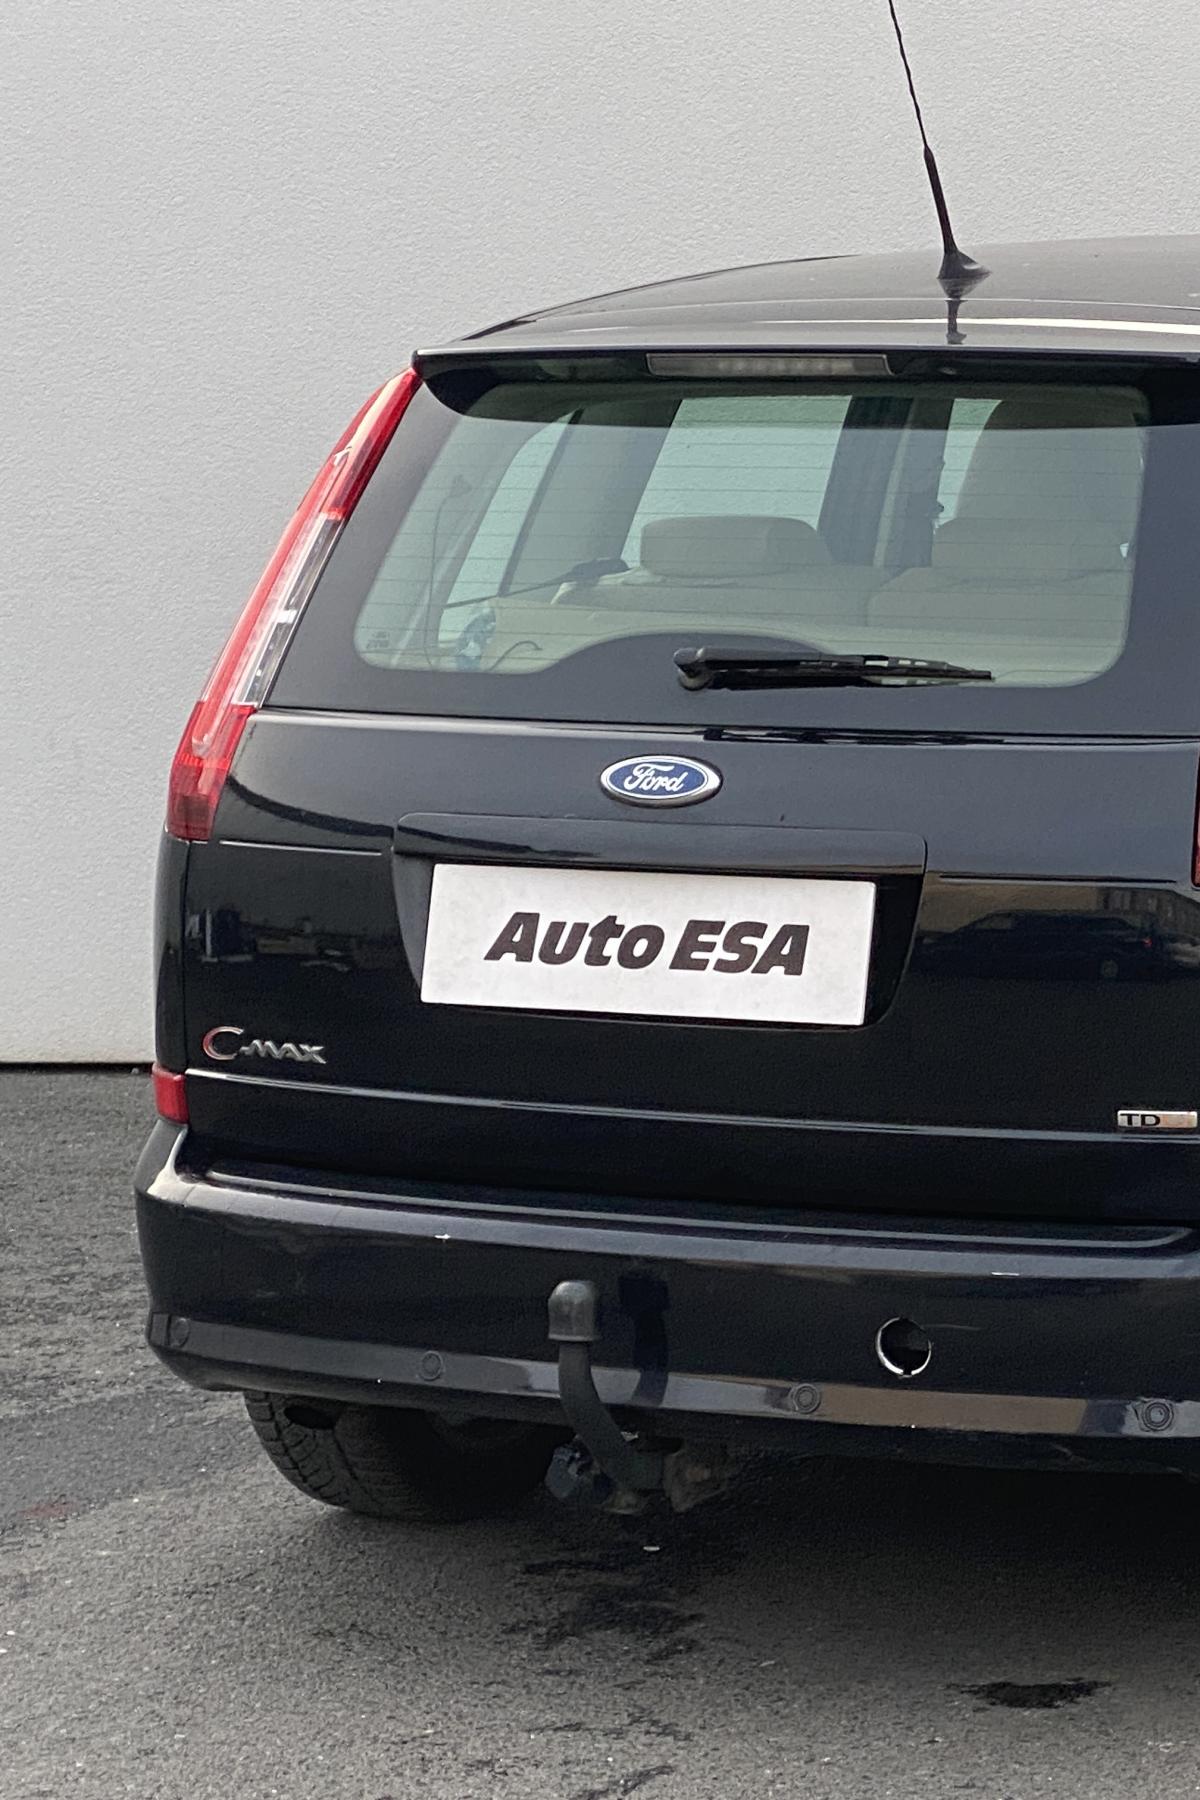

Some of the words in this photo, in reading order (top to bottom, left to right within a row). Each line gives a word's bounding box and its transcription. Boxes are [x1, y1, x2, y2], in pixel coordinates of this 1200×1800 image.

[623, 763, 688, 792] Ford
[484, 911, 665, 970] Auto
[668, 919, 810, 976] ESA
